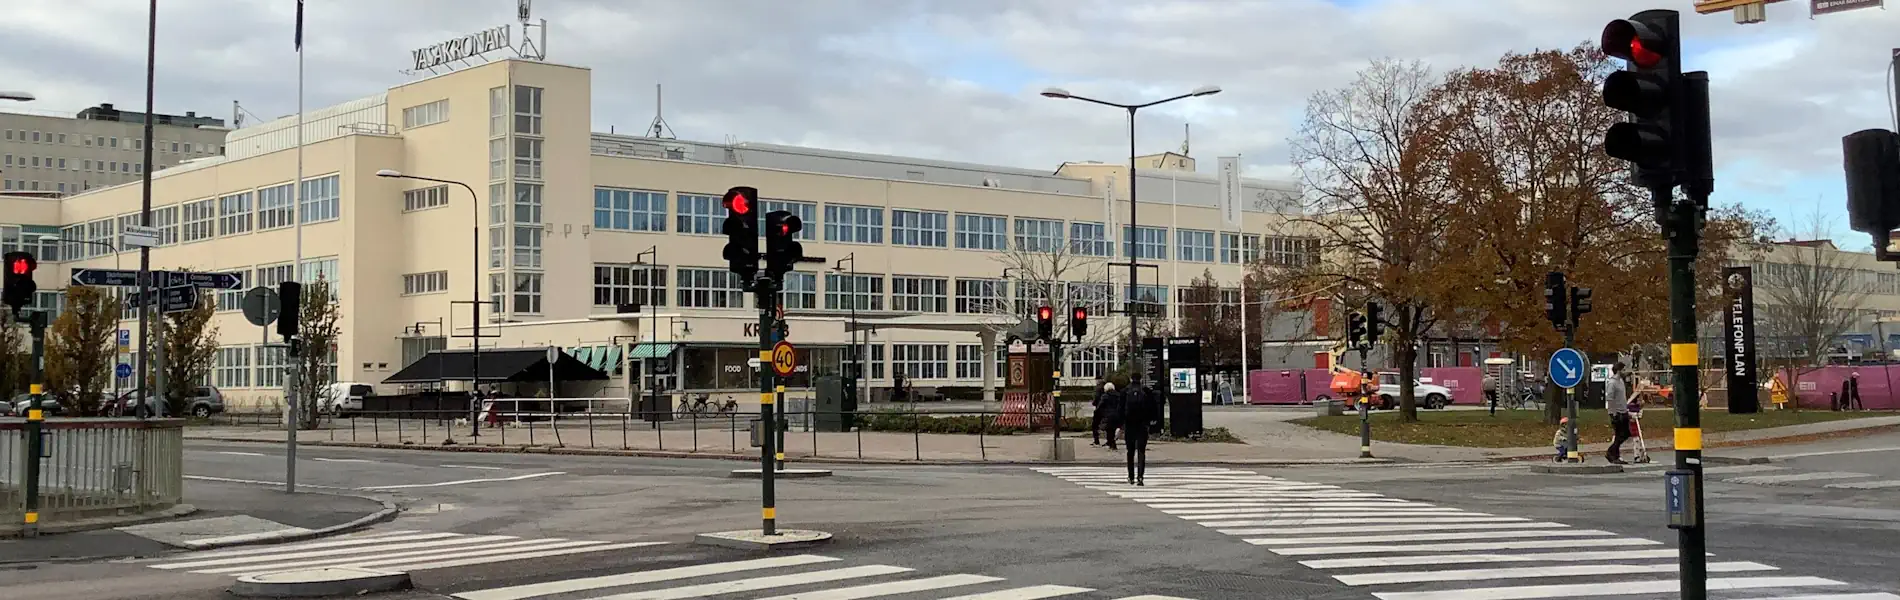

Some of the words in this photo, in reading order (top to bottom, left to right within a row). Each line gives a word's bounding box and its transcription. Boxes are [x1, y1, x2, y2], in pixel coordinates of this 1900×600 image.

[411, 24, 510, 70] VASAKRONAN
[122, 330, 129, 339] P
[744, 323, 789, 337] KRB
[1732, 297, 1746, 376] TELEFONPLAN
[776, 350, 793, 368] 40
[725, 365, 741, 373] FOOD
